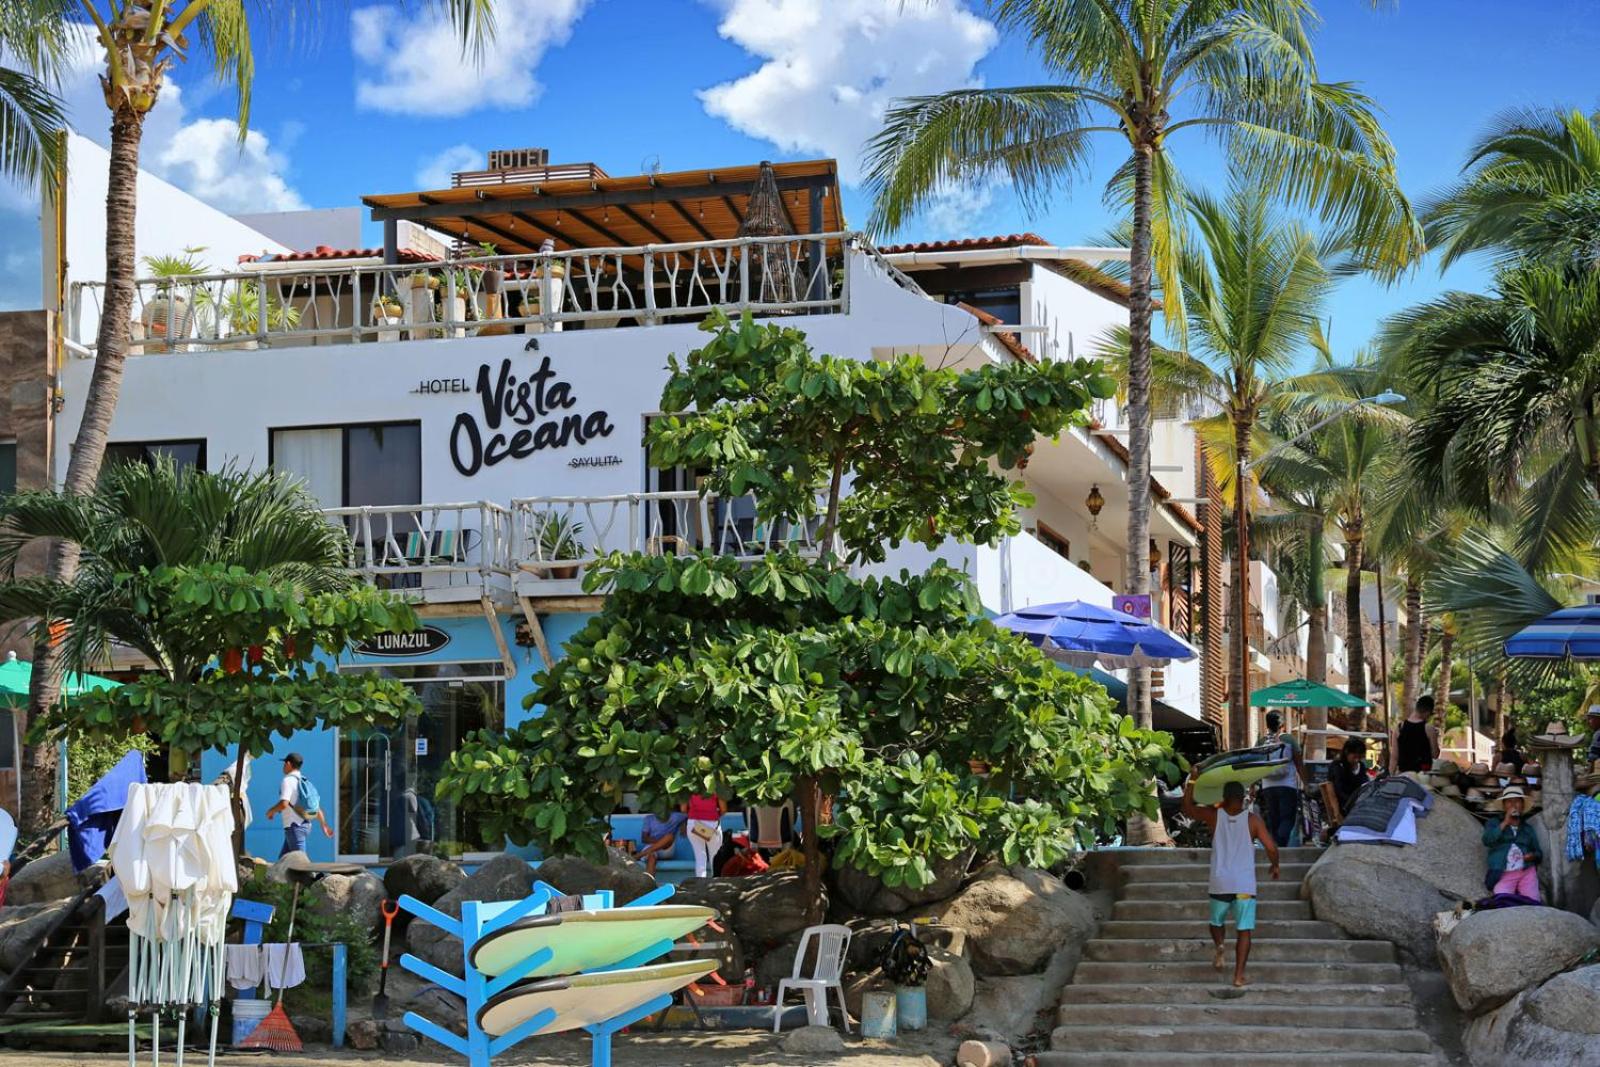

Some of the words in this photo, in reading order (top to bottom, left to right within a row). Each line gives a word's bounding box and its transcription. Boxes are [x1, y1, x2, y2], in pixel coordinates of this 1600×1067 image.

[489, 149, 545, 170] HOTEL
[420, 379, 470, 394] HOTEL
[476, 356, 577, 430] Vista
[450, 411, 614, 477] Oceana
[571, 456, 620, 468] SAYULITA
[377, 633, 431, 649] LUNAZUL
